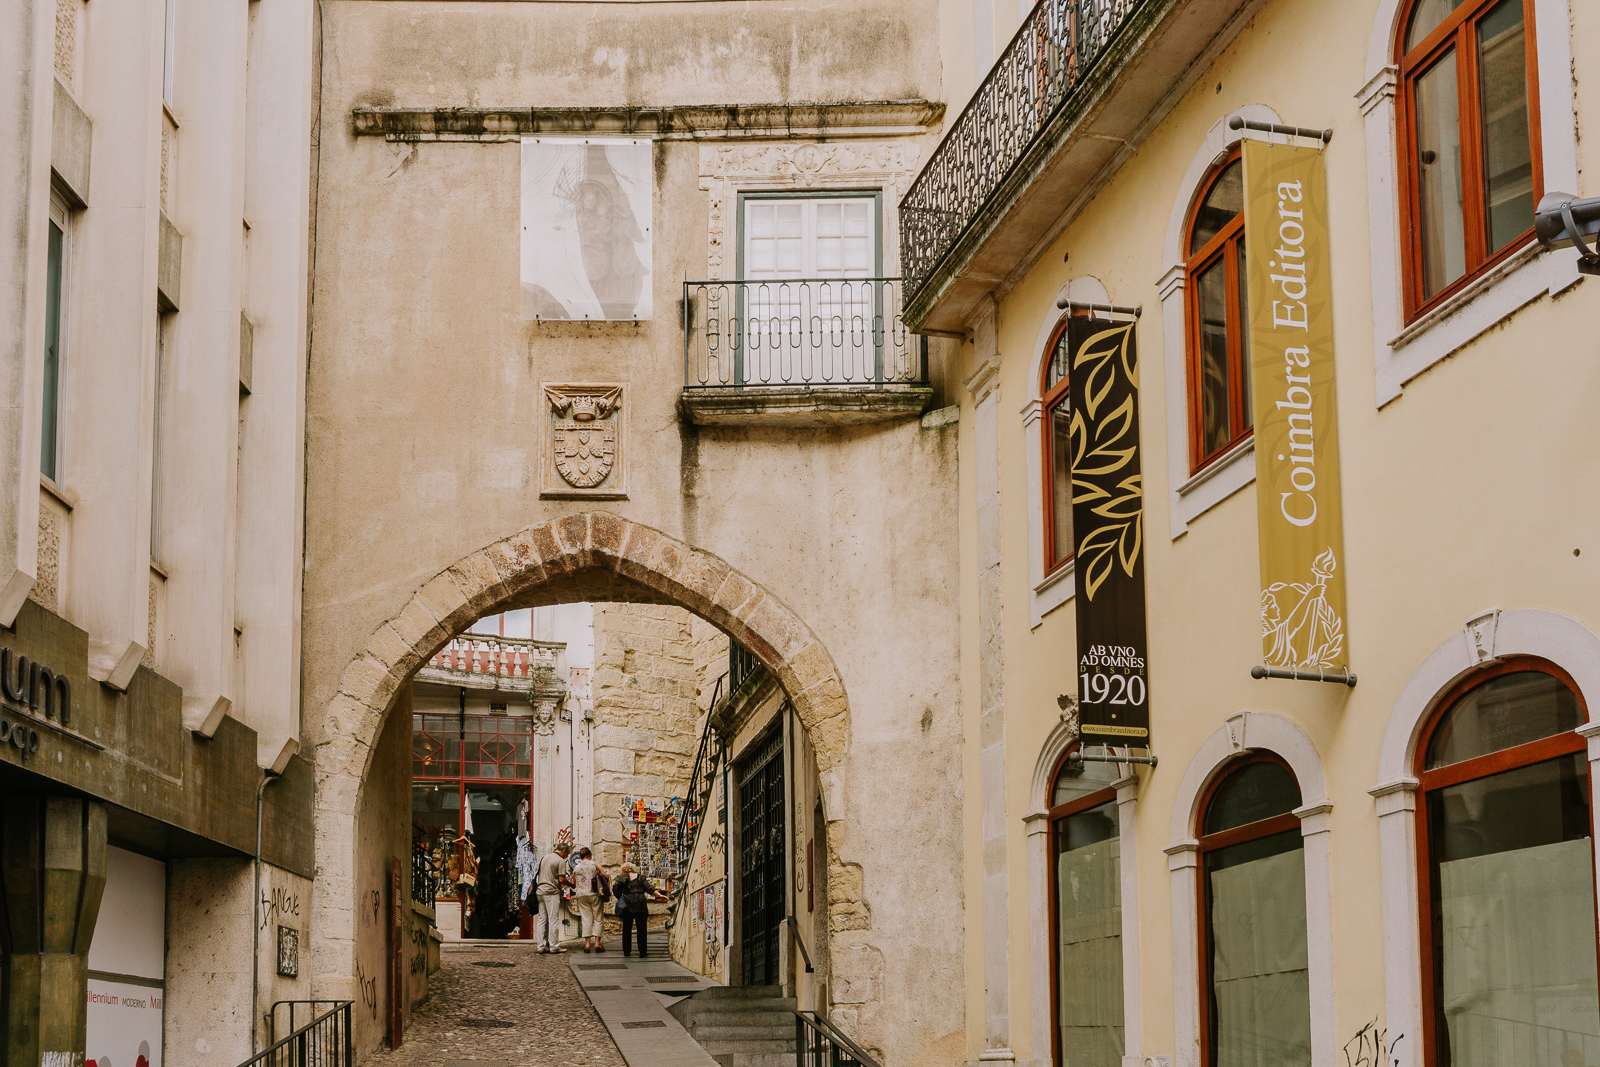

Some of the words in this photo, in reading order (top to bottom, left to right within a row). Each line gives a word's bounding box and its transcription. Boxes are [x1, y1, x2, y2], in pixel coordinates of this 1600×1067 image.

[1269, 179, 1309, 333] Editora
[1275, 344, 1318, 527] Coimbra
[1080, 654, 1099, 666] AD
[1101, 655, 1145, 668] OMNES
[1088, 644, 1106, 656] AB
[1108, 645, 1136, 658] VNO
[1080, 665, 1145, 676] DESDE
[1, 647, 71, 724] um
[1080, 672, 1146, 706] 1920
[121, 997, 147, 1009] MODERNO
